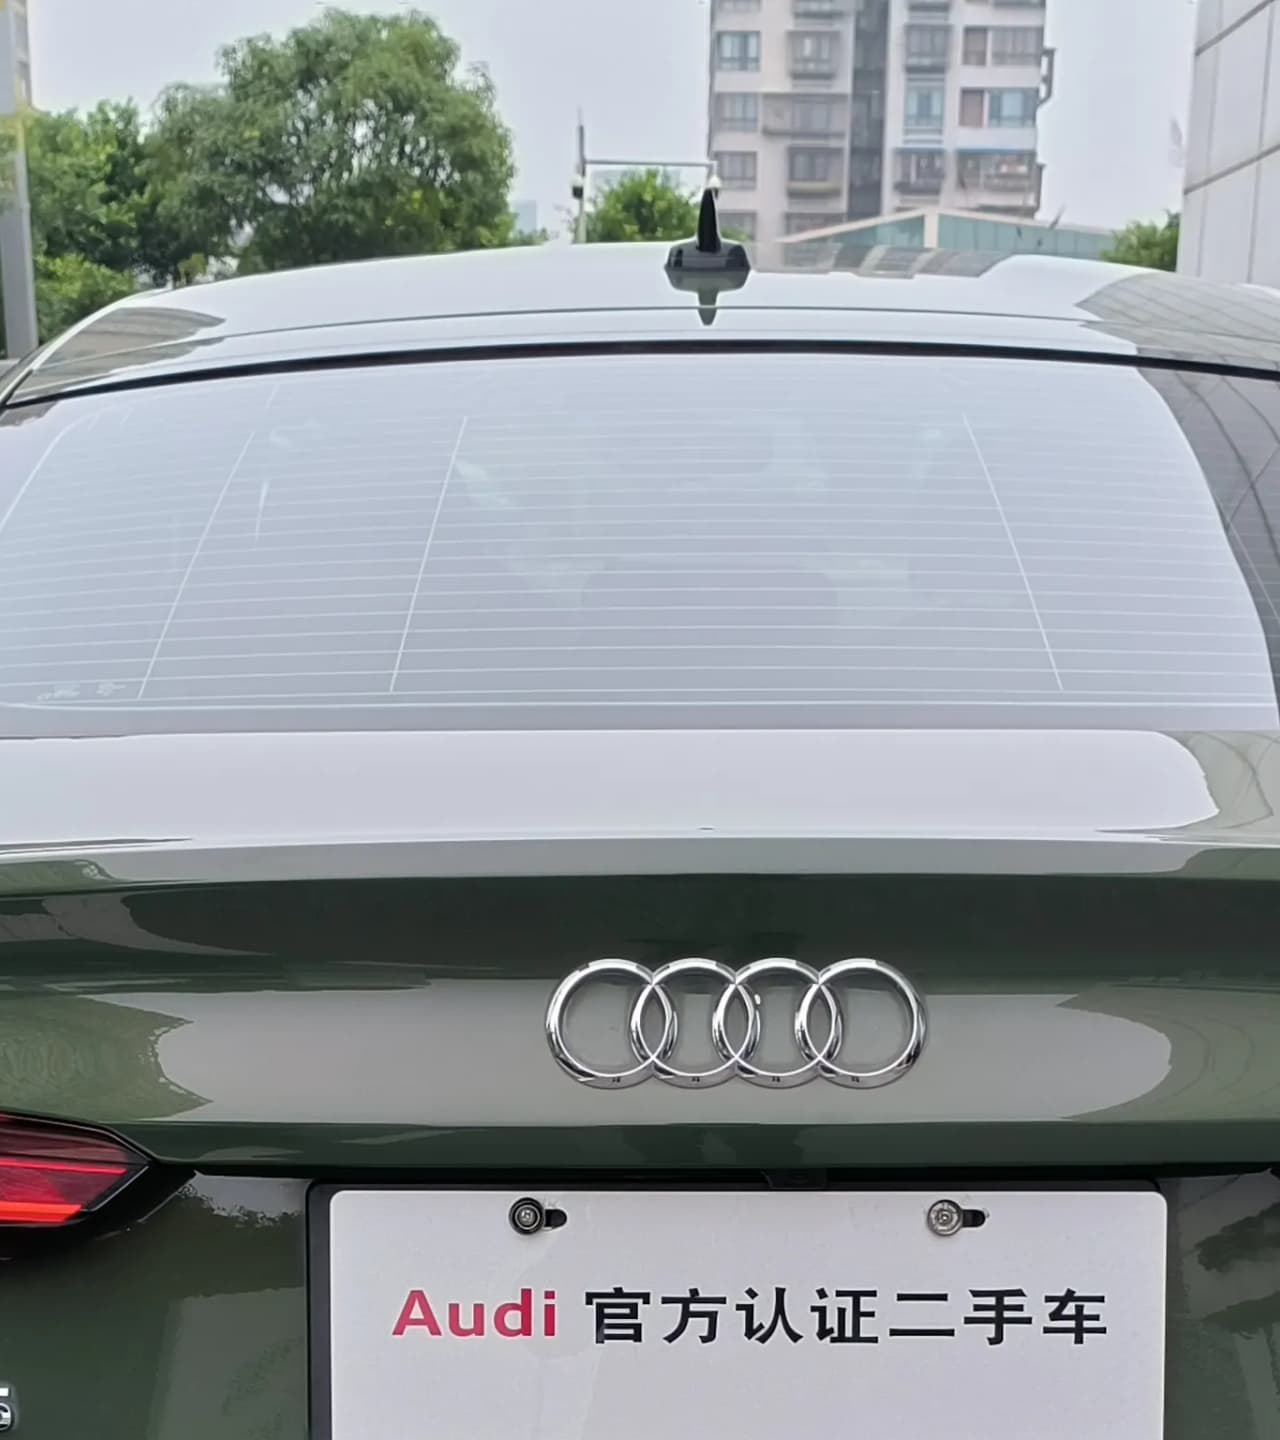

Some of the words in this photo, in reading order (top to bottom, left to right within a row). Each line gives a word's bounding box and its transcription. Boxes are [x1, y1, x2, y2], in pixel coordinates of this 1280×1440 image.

[393, 1288, 557, 1339] Audi
[584, 1286, 1108, 1346] 官方认证二手车
